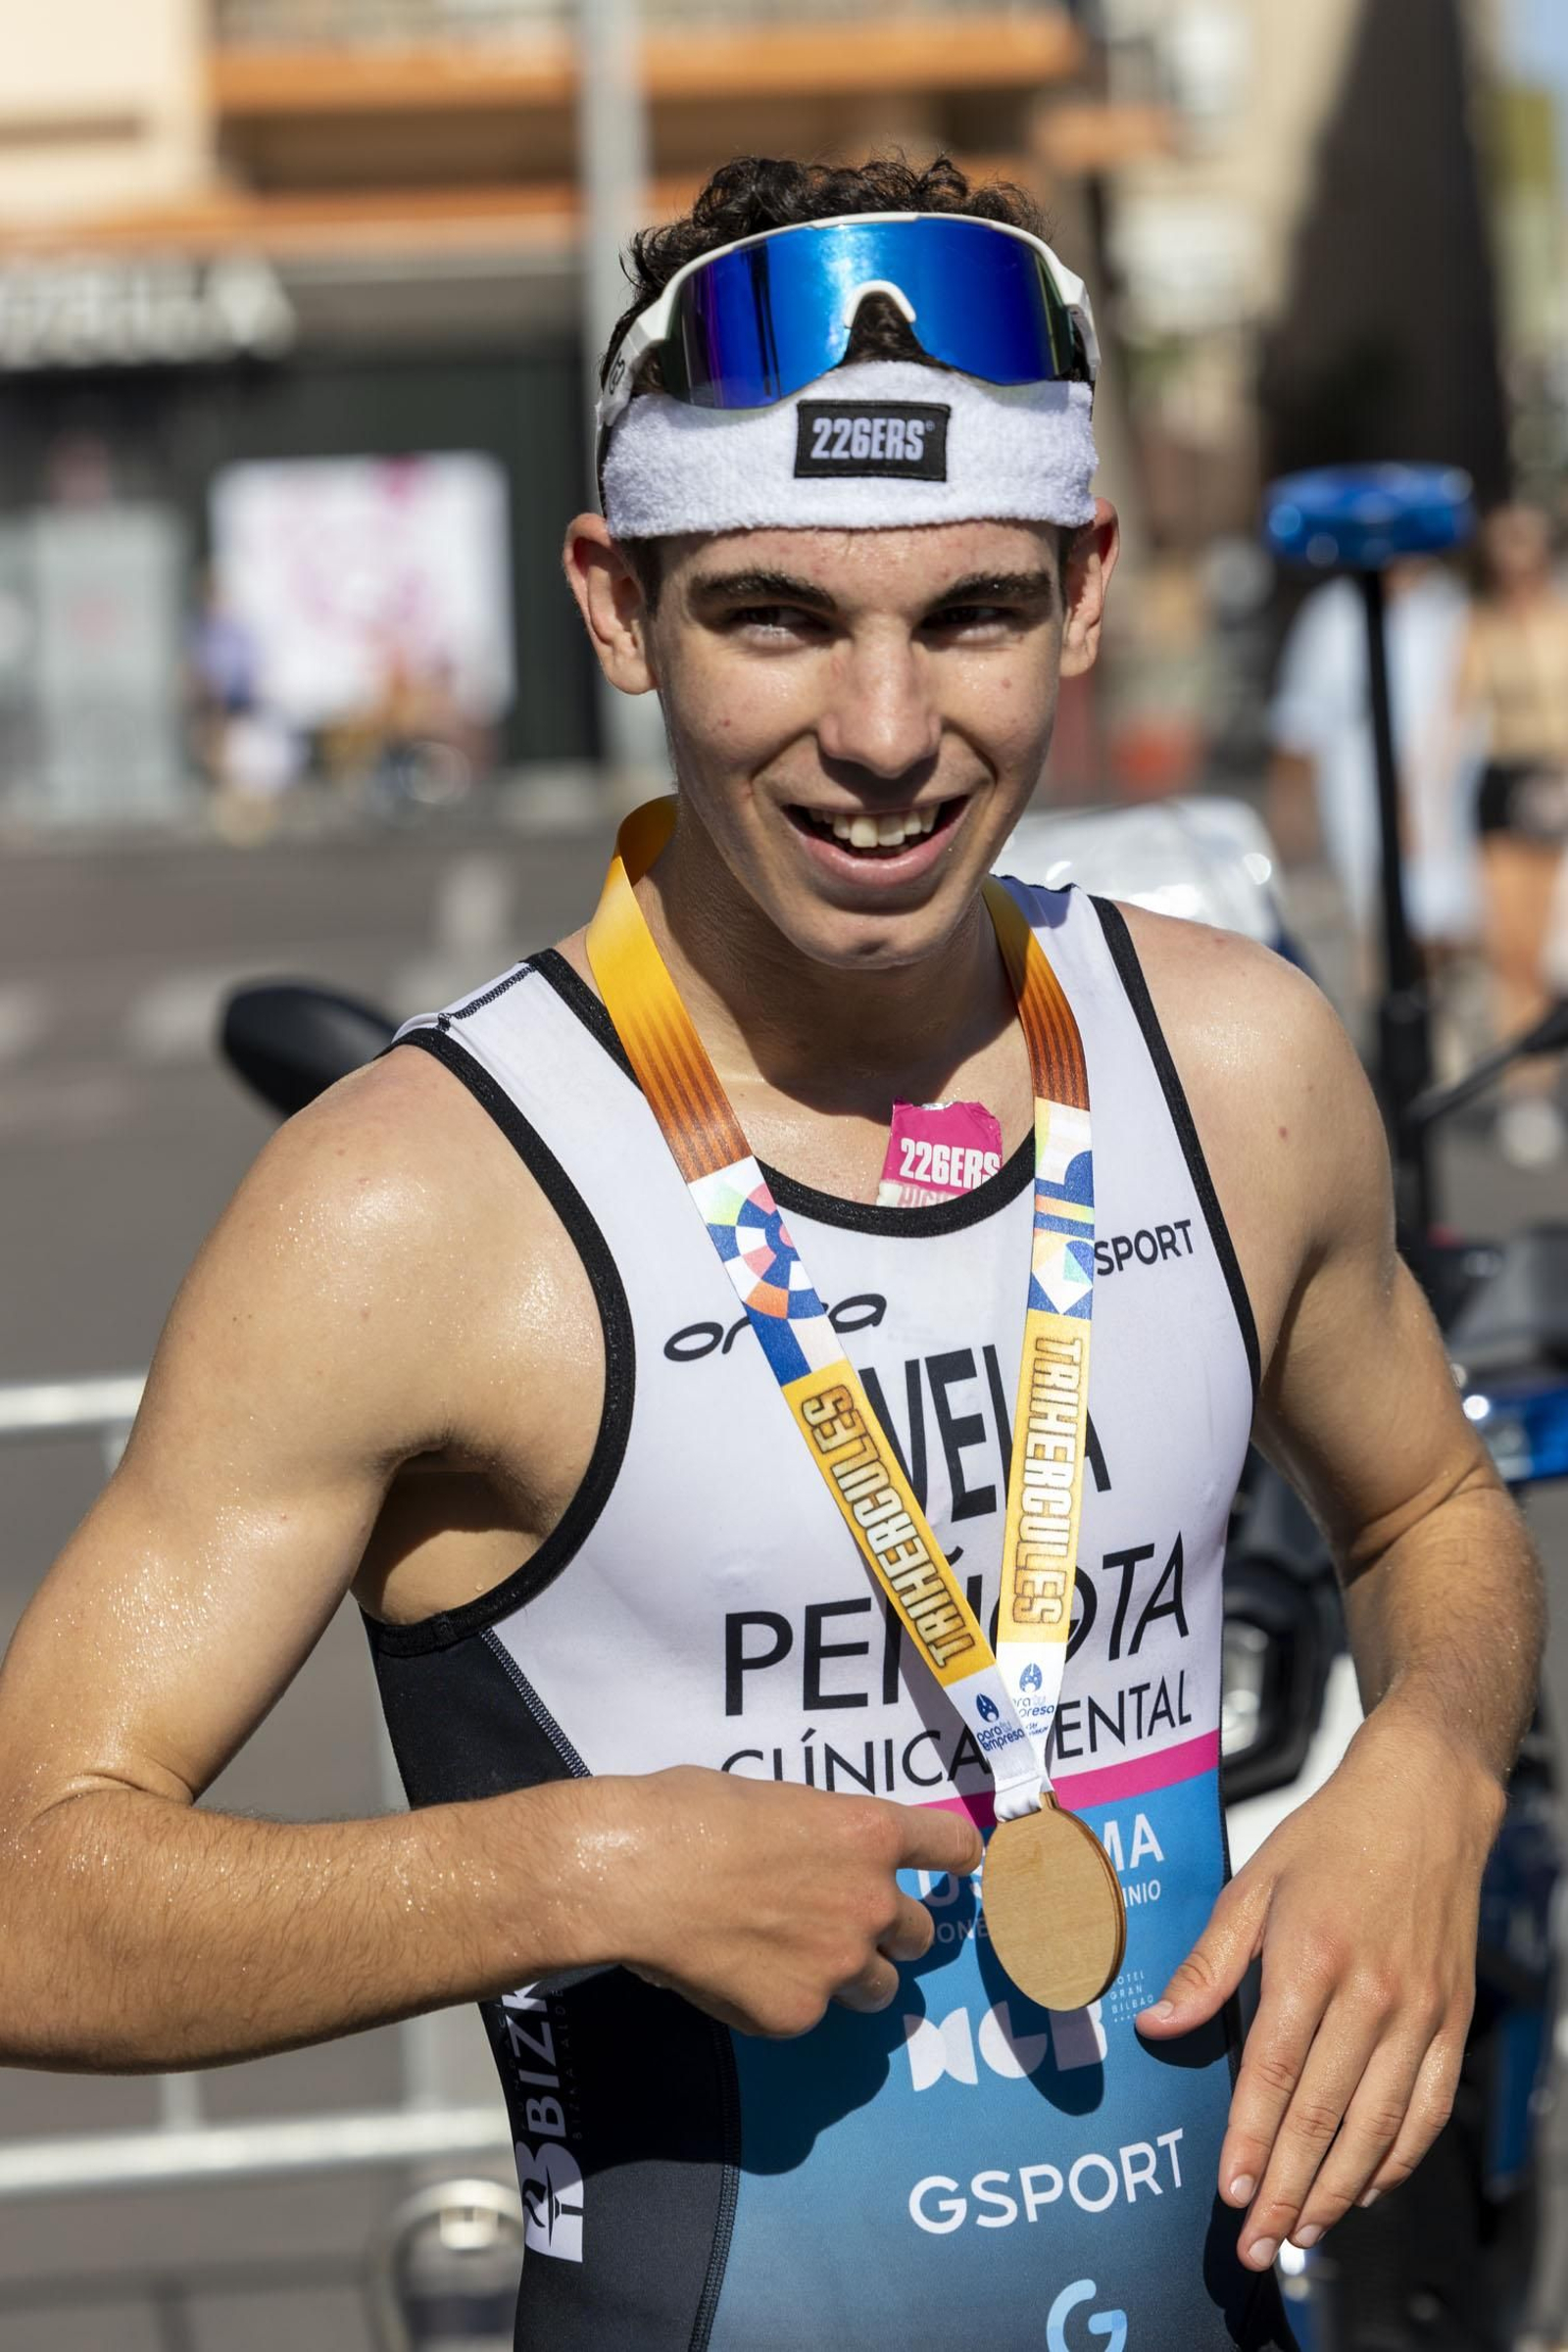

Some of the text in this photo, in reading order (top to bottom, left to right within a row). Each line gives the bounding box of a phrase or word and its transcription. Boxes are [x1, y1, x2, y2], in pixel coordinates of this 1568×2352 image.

[900, 1138, 1001, 1190] 226ERS
[1094, 1219, 1193, 1276] SPORT
[663, 1294, 887, 1361] ora
[1012, 1337, 1083, 1624] TRIHERCULES
[801, 1384, 978, 1669] TRIHERCULES
[981, 1728, 1025, 1751] empresa
[1054, 1670, 1192, 1759] ENTAL
[1109, 1984, 1143, 2000] GRAN
[1111, 1994, 1154, 2015] BILBAO
[1113, 1970, 1146, 1985] OTEL
[502, 1981, 566, 2138] BIZK
[908, 2128, 1183, 2234] GSPORT
